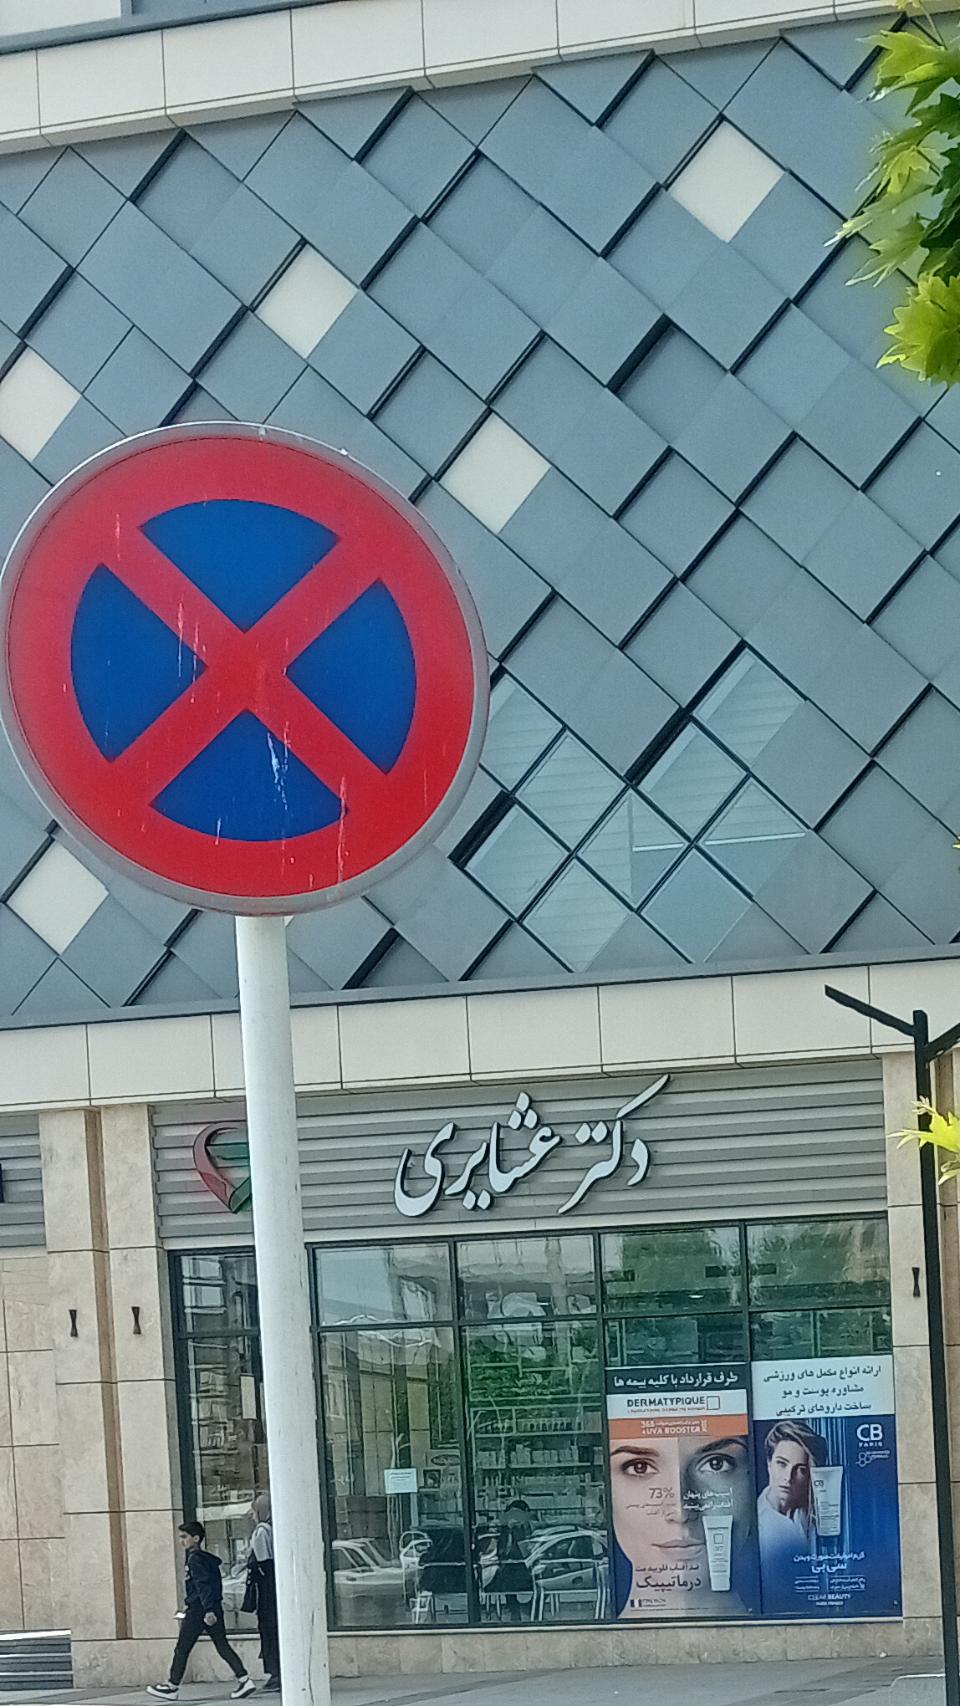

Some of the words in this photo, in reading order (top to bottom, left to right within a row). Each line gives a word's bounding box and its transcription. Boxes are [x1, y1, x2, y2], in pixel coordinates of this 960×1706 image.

[556, 1073, 670, 1215] دکتر
[394, 1091, 562, 1217] عشایری
[713, 1370, 738, 1387] طرف
[763, 1370, 796, 1382] ورزشی
[797, 1368, 814, 1380] های
[816, 1368, 837, 1379] مکمل
[839, 1366, 860, 1380] انواع
[613, 1375, 625, 1387] ها
[626, 1377, 646, 1389] بیمه
[648, 1374, 669, 1388] کلیه
[670, 1373, 678, 1388] با
[680, 1372, 712, 1388] قرارداد
[782, 1390, 792, 1399] مو
[802, 1386, 830, 1398] پوست
[831, 1383, 864, 1397] مشاوره
[626, 1396, 705, 1408] DERMATYPIQUE
[844, 1401, 871, 1411] ساخت
[776, 1404, 805, 1416] ترکیبی
[807, 1403, 842, 1415] داروهای
[856, 1424, 883, 1442] CB
[648, 1487, 675, 1500] 73%
[635, 1574, 702, 1593] درماتیپیک
